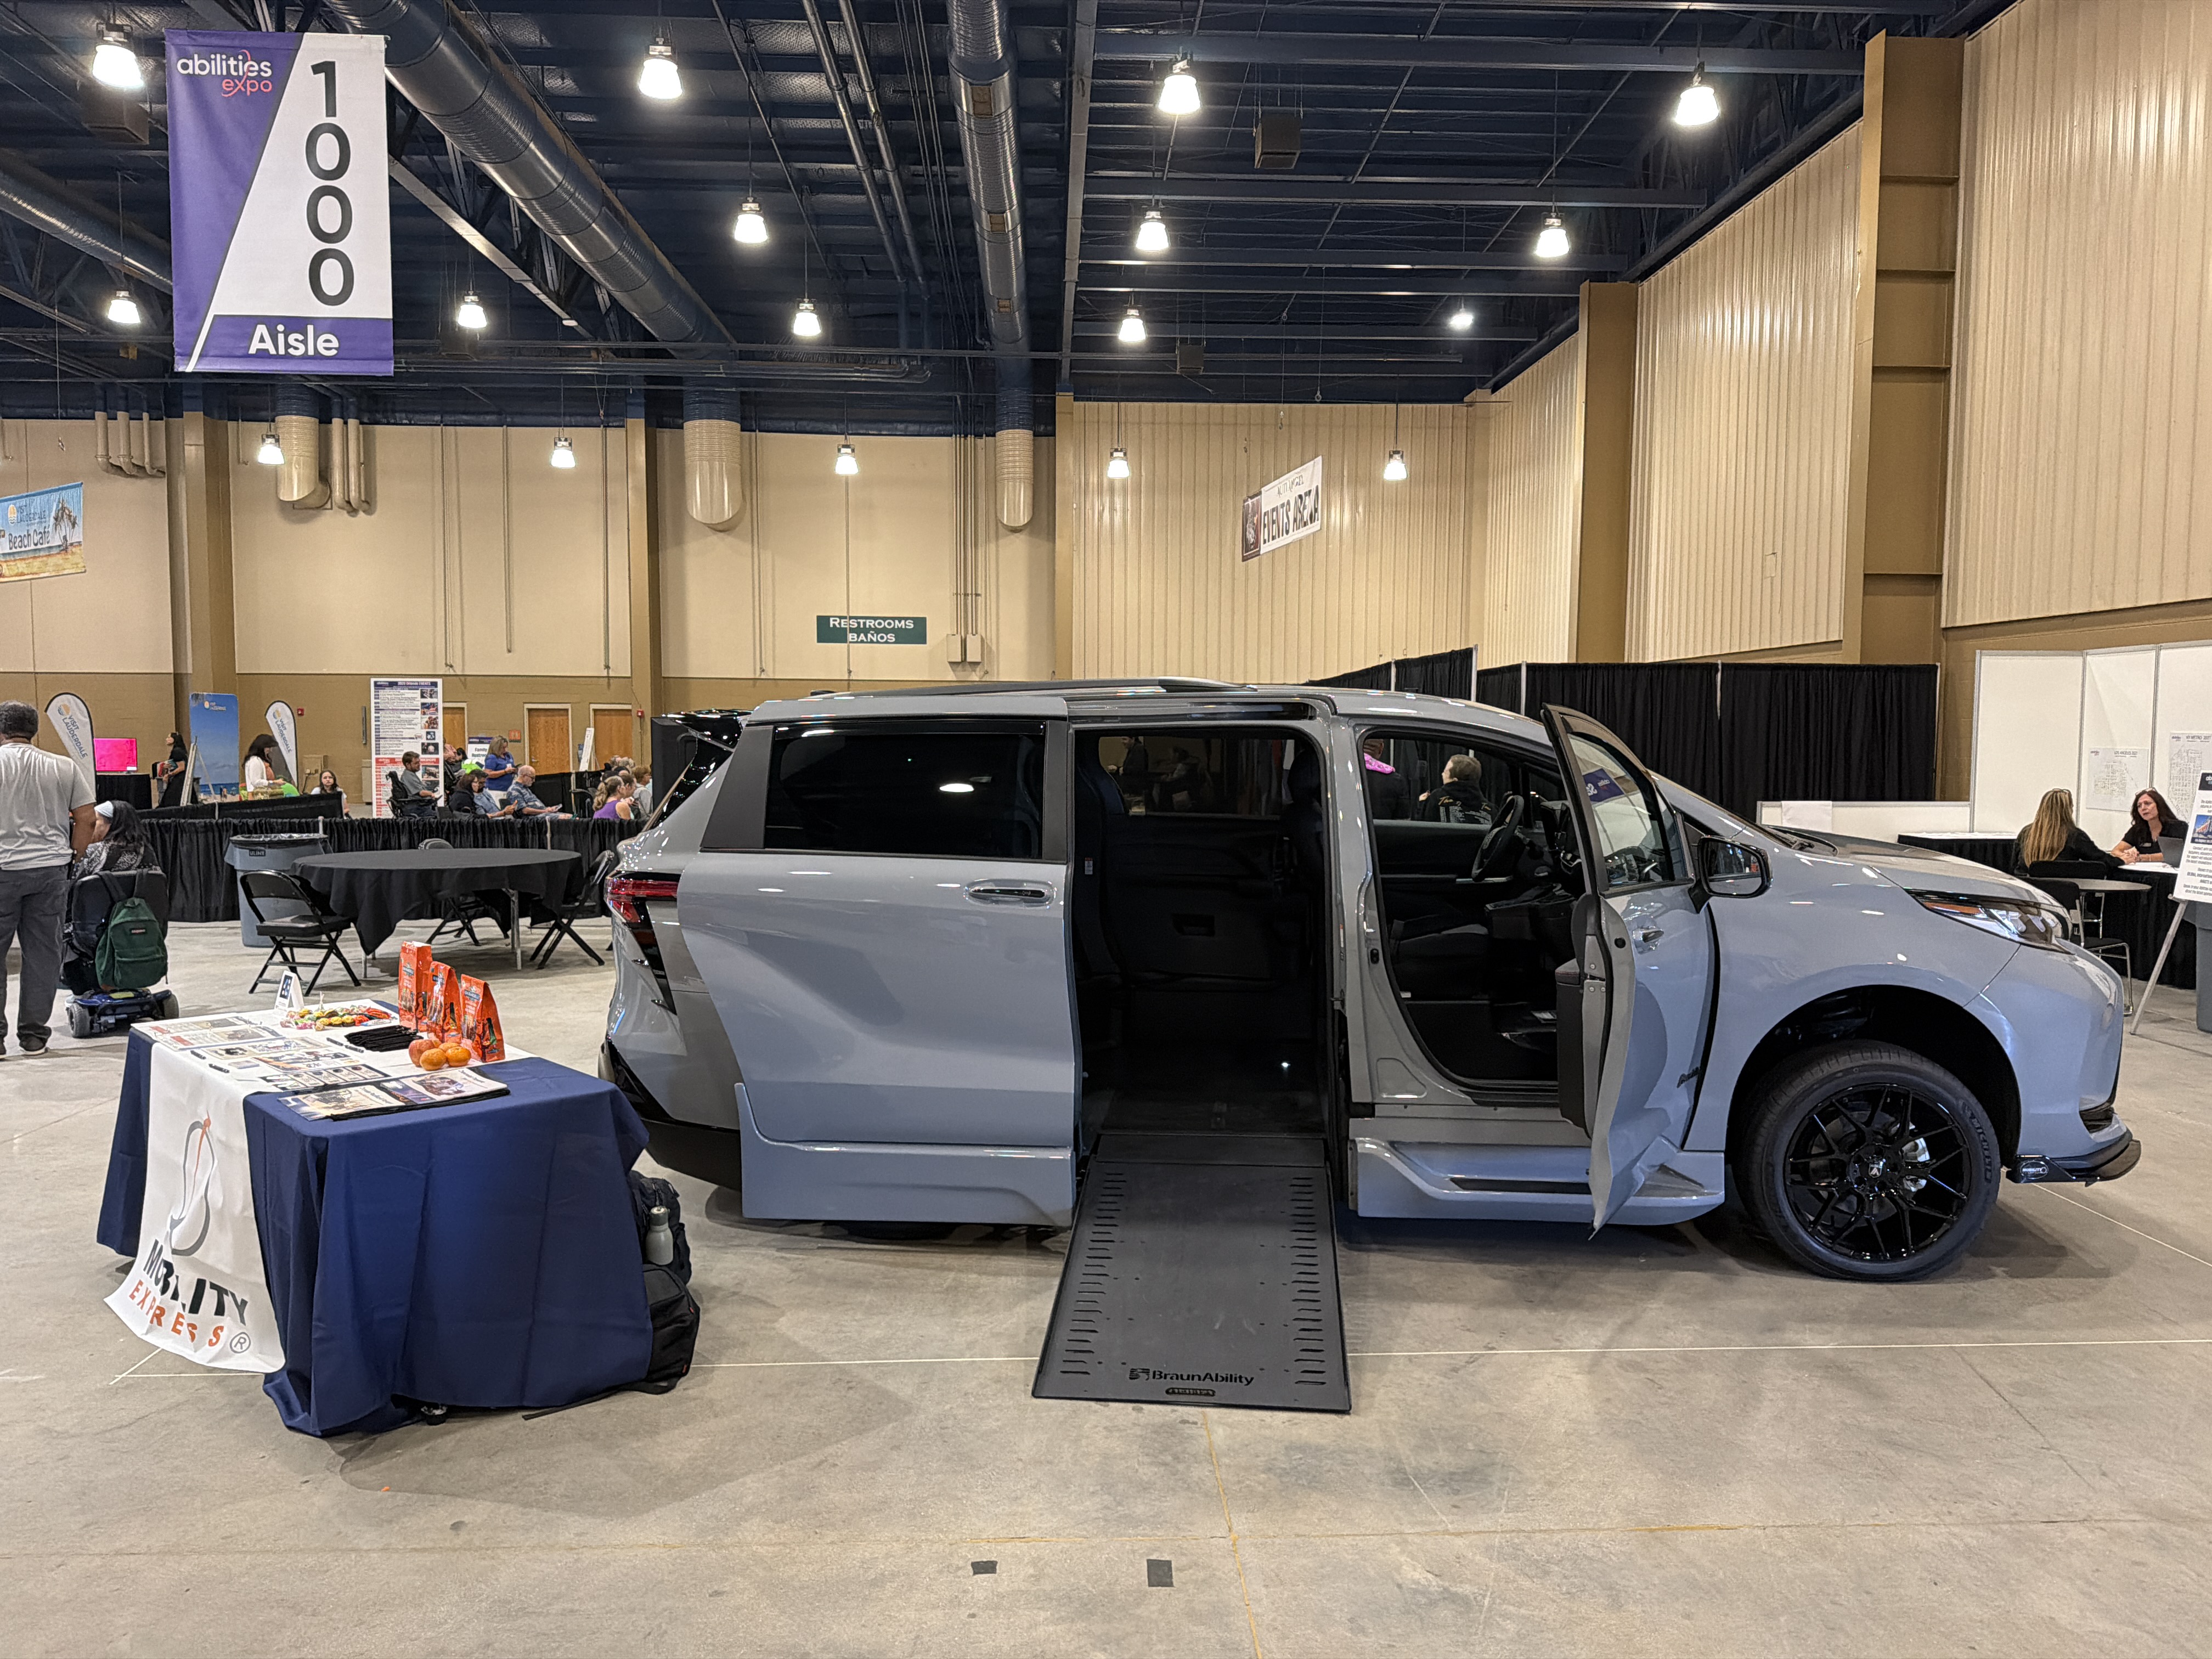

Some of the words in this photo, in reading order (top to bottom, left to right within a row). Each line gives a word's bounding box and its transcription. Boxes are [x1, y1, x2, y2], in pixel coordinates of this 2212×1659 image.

[177, 53, 272, 77] abilities
[221, 78, 273, 97] expo
[305, 60, 354, 306] 1000
[248, 324, 339, 356] Aisle
[1263, 499, 1291, 545] EVENTS
[8, 529, 32, 550] Beach
[33, 524, 50, 546] Café
[830, 617, 914, 629] RESTROOMS
[849, 631, 895, 642] BAÑOS
[68, 715, 80, 730] VISIT
[275, 720, 292, 753] LAUDERDALE
[62, 717, 88, 758] LAUDERDALE
[1968, 1111, 1993, 1183] MICHELIN
[143, 1239, 249, 1326] MOBIITY
[1152, 1370, 1255, 1386] BraunAbility
